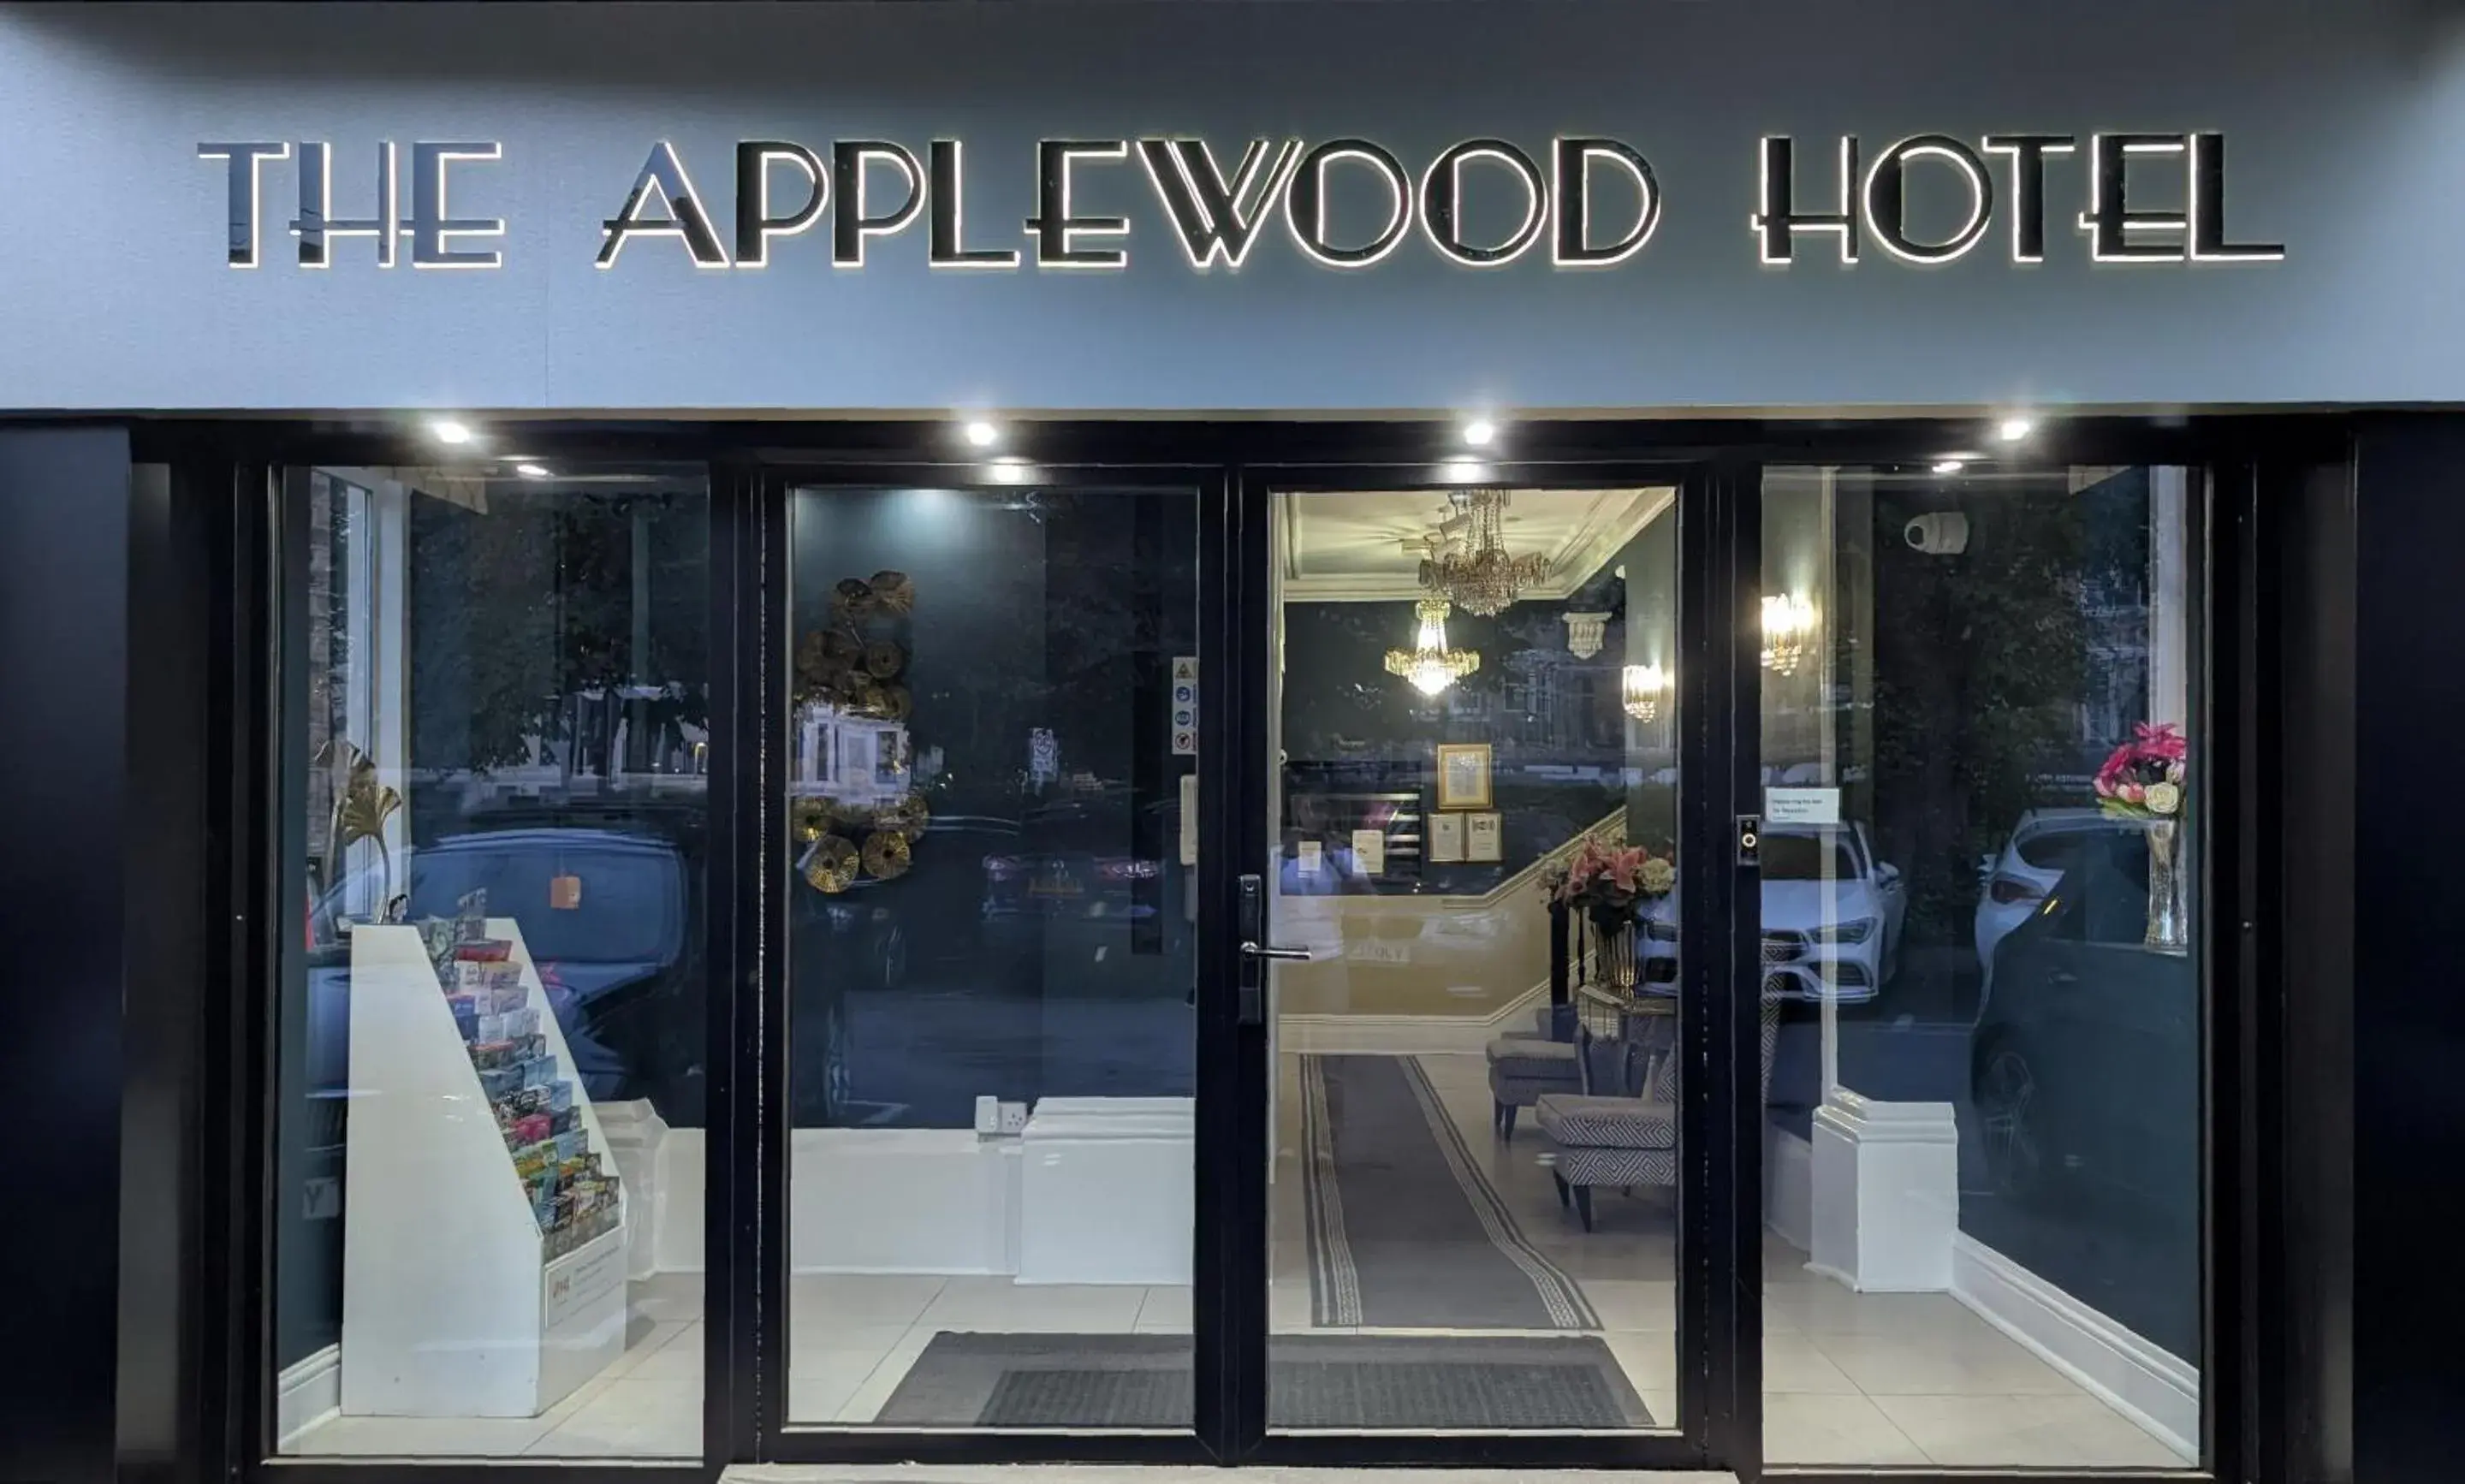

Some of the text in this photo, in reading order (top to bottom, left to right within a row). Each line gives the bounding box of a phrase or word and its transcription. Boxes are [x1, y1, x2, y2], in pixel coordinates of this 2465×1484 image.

[197, 133, 2285, 269] THE APPLEWOOD HOTEL
